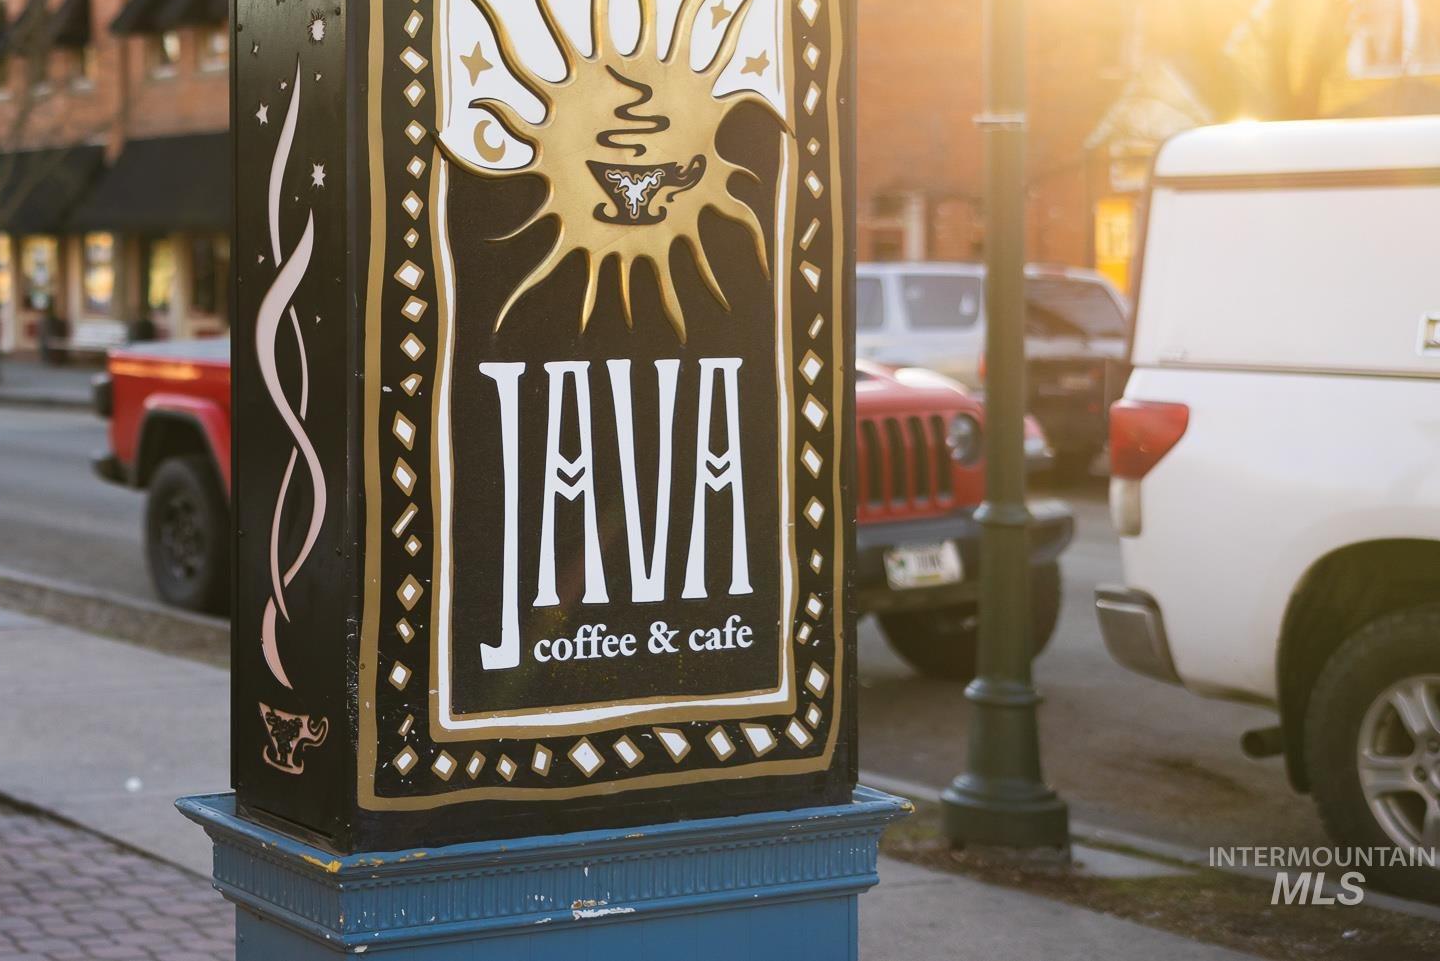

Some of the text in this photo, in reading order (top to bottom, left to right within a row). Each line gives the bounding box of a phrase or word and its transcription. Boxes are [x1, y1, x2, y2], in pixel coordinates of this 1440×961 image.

[478, 357, 754, 671] JAVA
[533, 614, 754, 662] coffee & cafe
